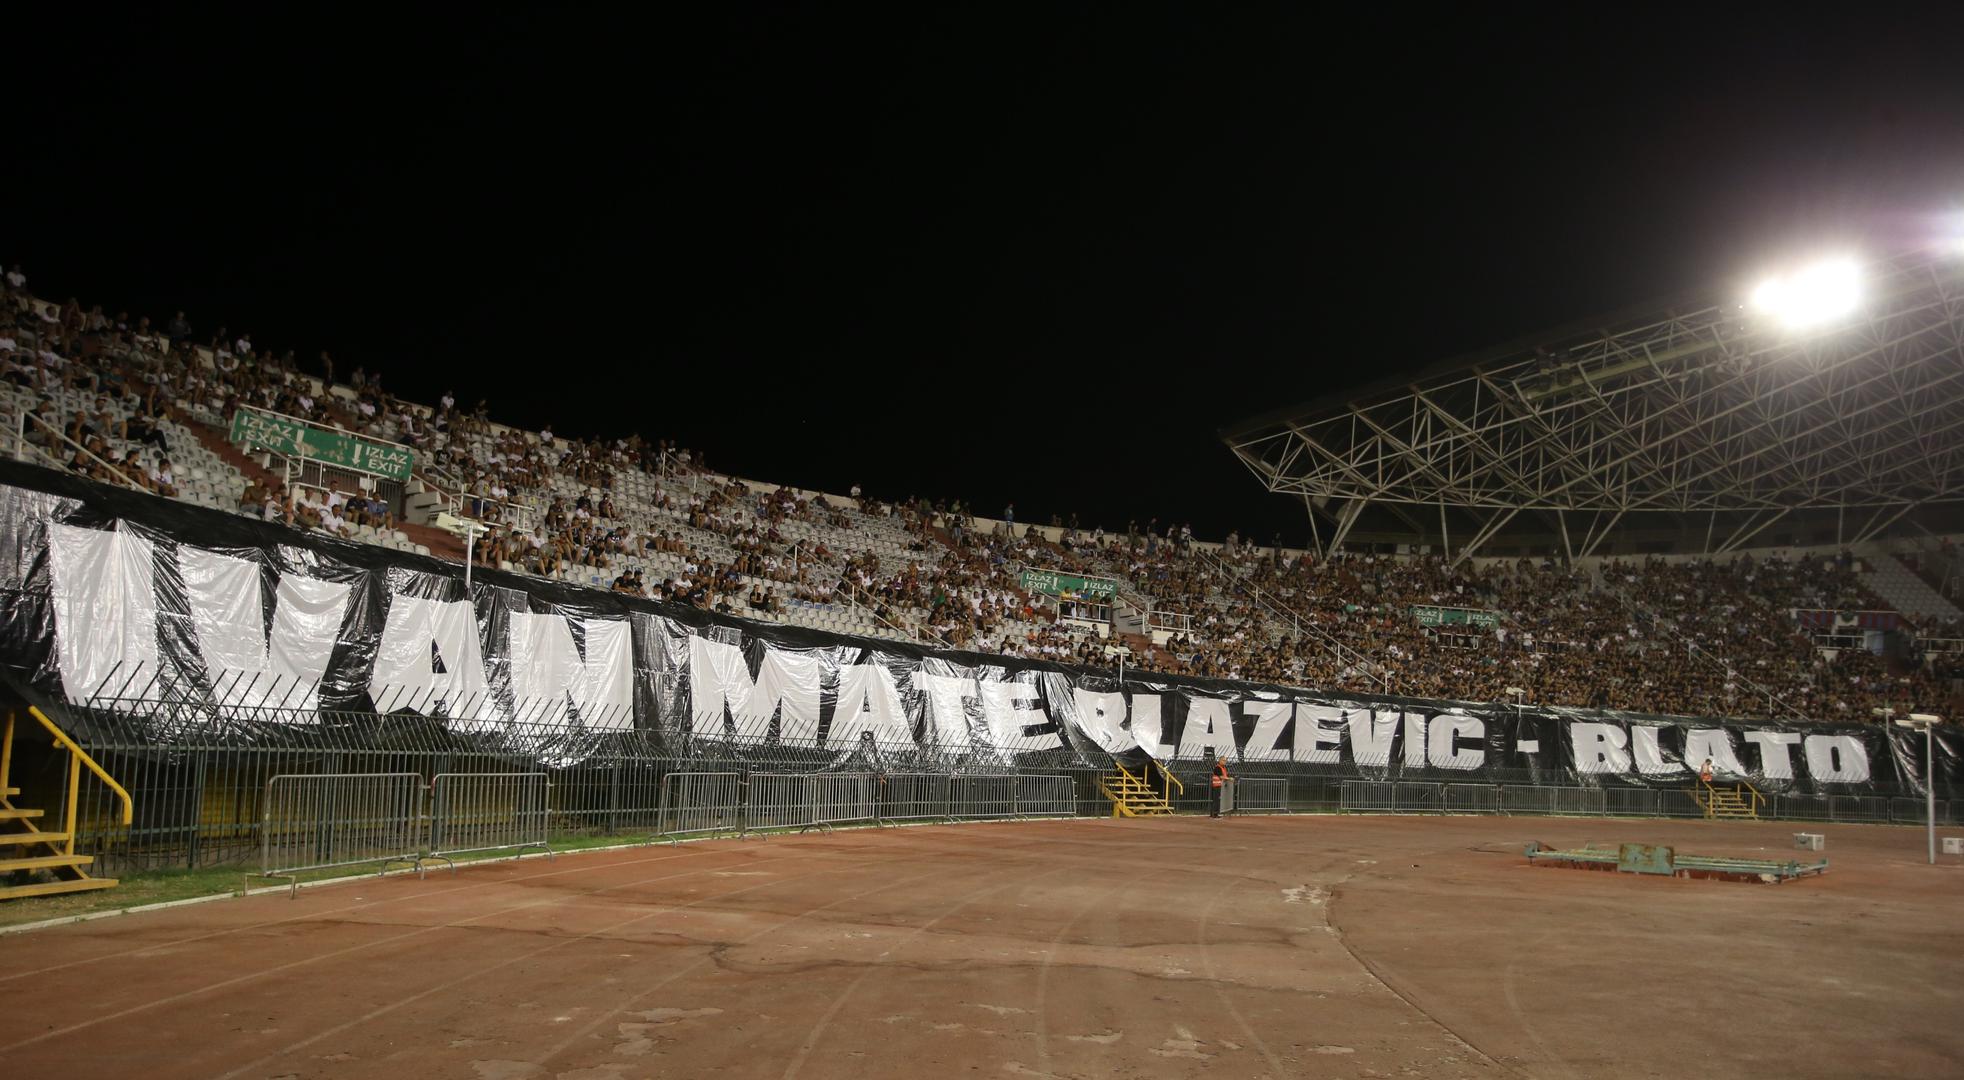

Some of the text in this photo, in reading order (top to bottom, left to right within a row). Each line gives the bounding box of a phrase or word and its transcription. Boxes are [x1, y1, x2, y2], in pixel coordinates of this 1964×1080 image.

[243, 415, 293, 438] IZLAZ
[366, 446, 408, 465] IZLAZ
[368, 459, 401, 474] EXIT
[1026, 573, 1052, 583] IZLAZ
[1089, 582, 1114, 592] IZLAZ
[50, 518, 635, 733] IVAN
[689, 634, 1063, 754] MATE
[1570, 722, 1870, 783] BLATO
